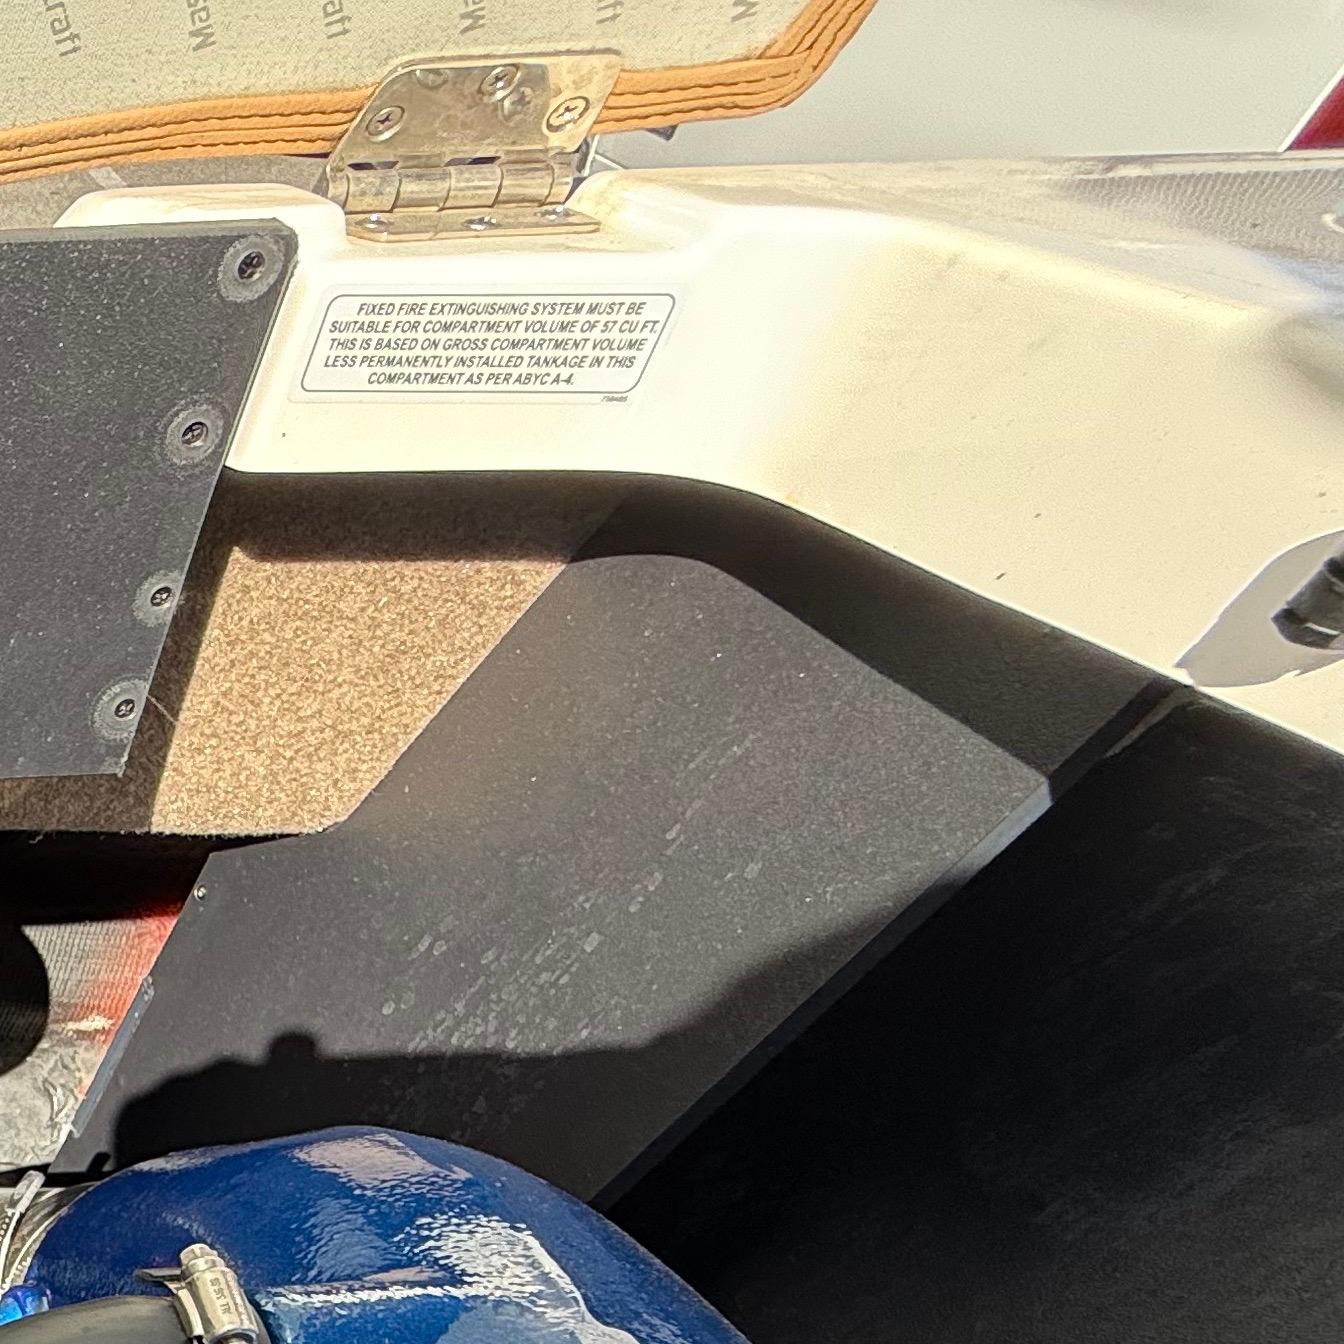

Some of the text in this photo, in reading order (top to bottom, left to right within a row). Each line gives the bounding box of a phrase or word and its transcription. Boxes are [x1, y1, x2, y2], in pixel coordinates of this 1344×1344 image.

[357, 302, 647, 317] FIXED FIRE EXTINGUISHING SYSTEM MUST BE
[328, 320, 660, 334] SUITABLE FOR COMPARTMENT VOLUME OF 57 CU FT.
[328, 337, 647, 352] THIS IS BASED ON GROSS COMPARTMENT VOLUME
[324, 355, 636, 369] LESS PERMANENTLY INSTALLED TANKAGE IN THIS
[367, 372, 464, 386] COMPARTMENT
[465, 372, 483, 386] AS
[485, 372, 511, 386] PER
[513, 372, 549, 386] ABYC
